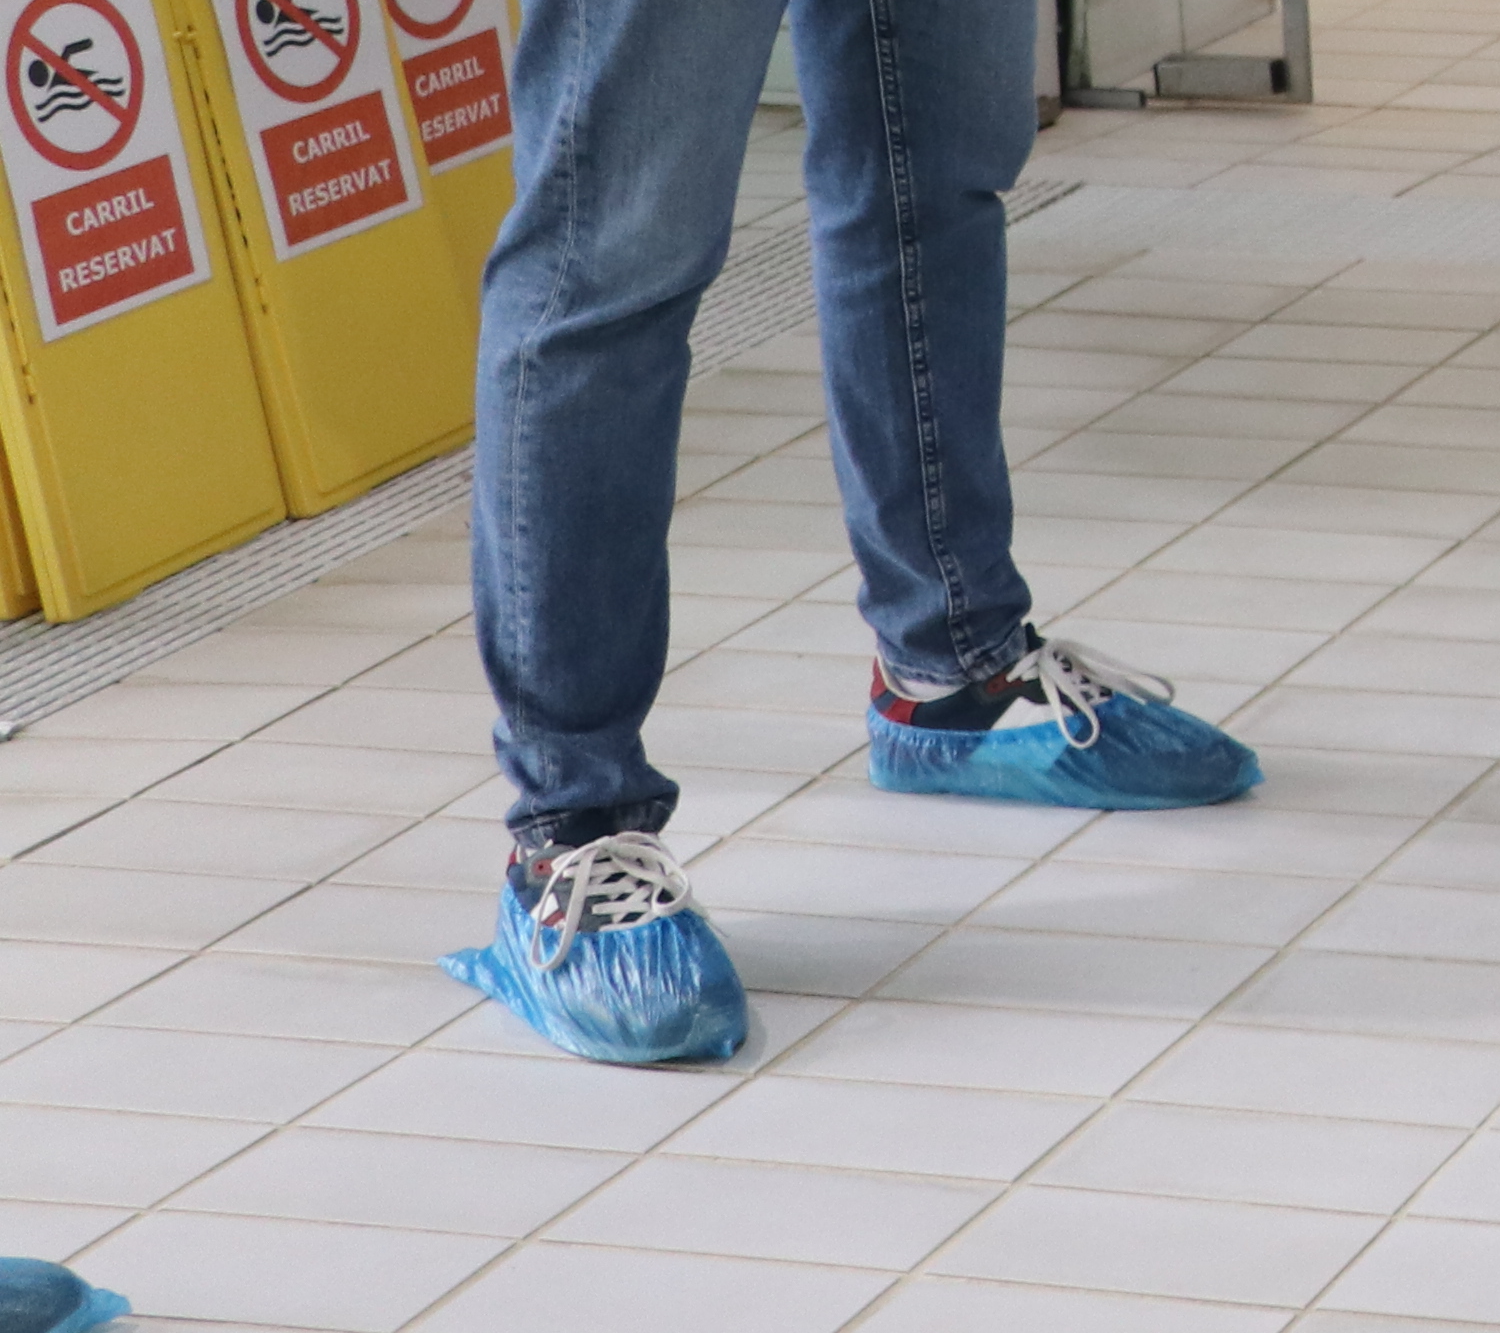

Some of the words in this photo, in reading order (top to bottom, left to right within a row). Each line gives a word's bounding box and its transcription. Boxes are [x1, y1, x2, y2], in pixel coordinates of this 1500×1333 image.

[415, 56, 485, 98] CARRIL
[292, 120, 371, 164] CARRIL
[420, 94, 500, 142] ESERVAT
[288, 159, 392, 216] RESERVAT
[66, 188, 155, 237] CARRIL
[58, 227, 177, 293] RESERVAT
